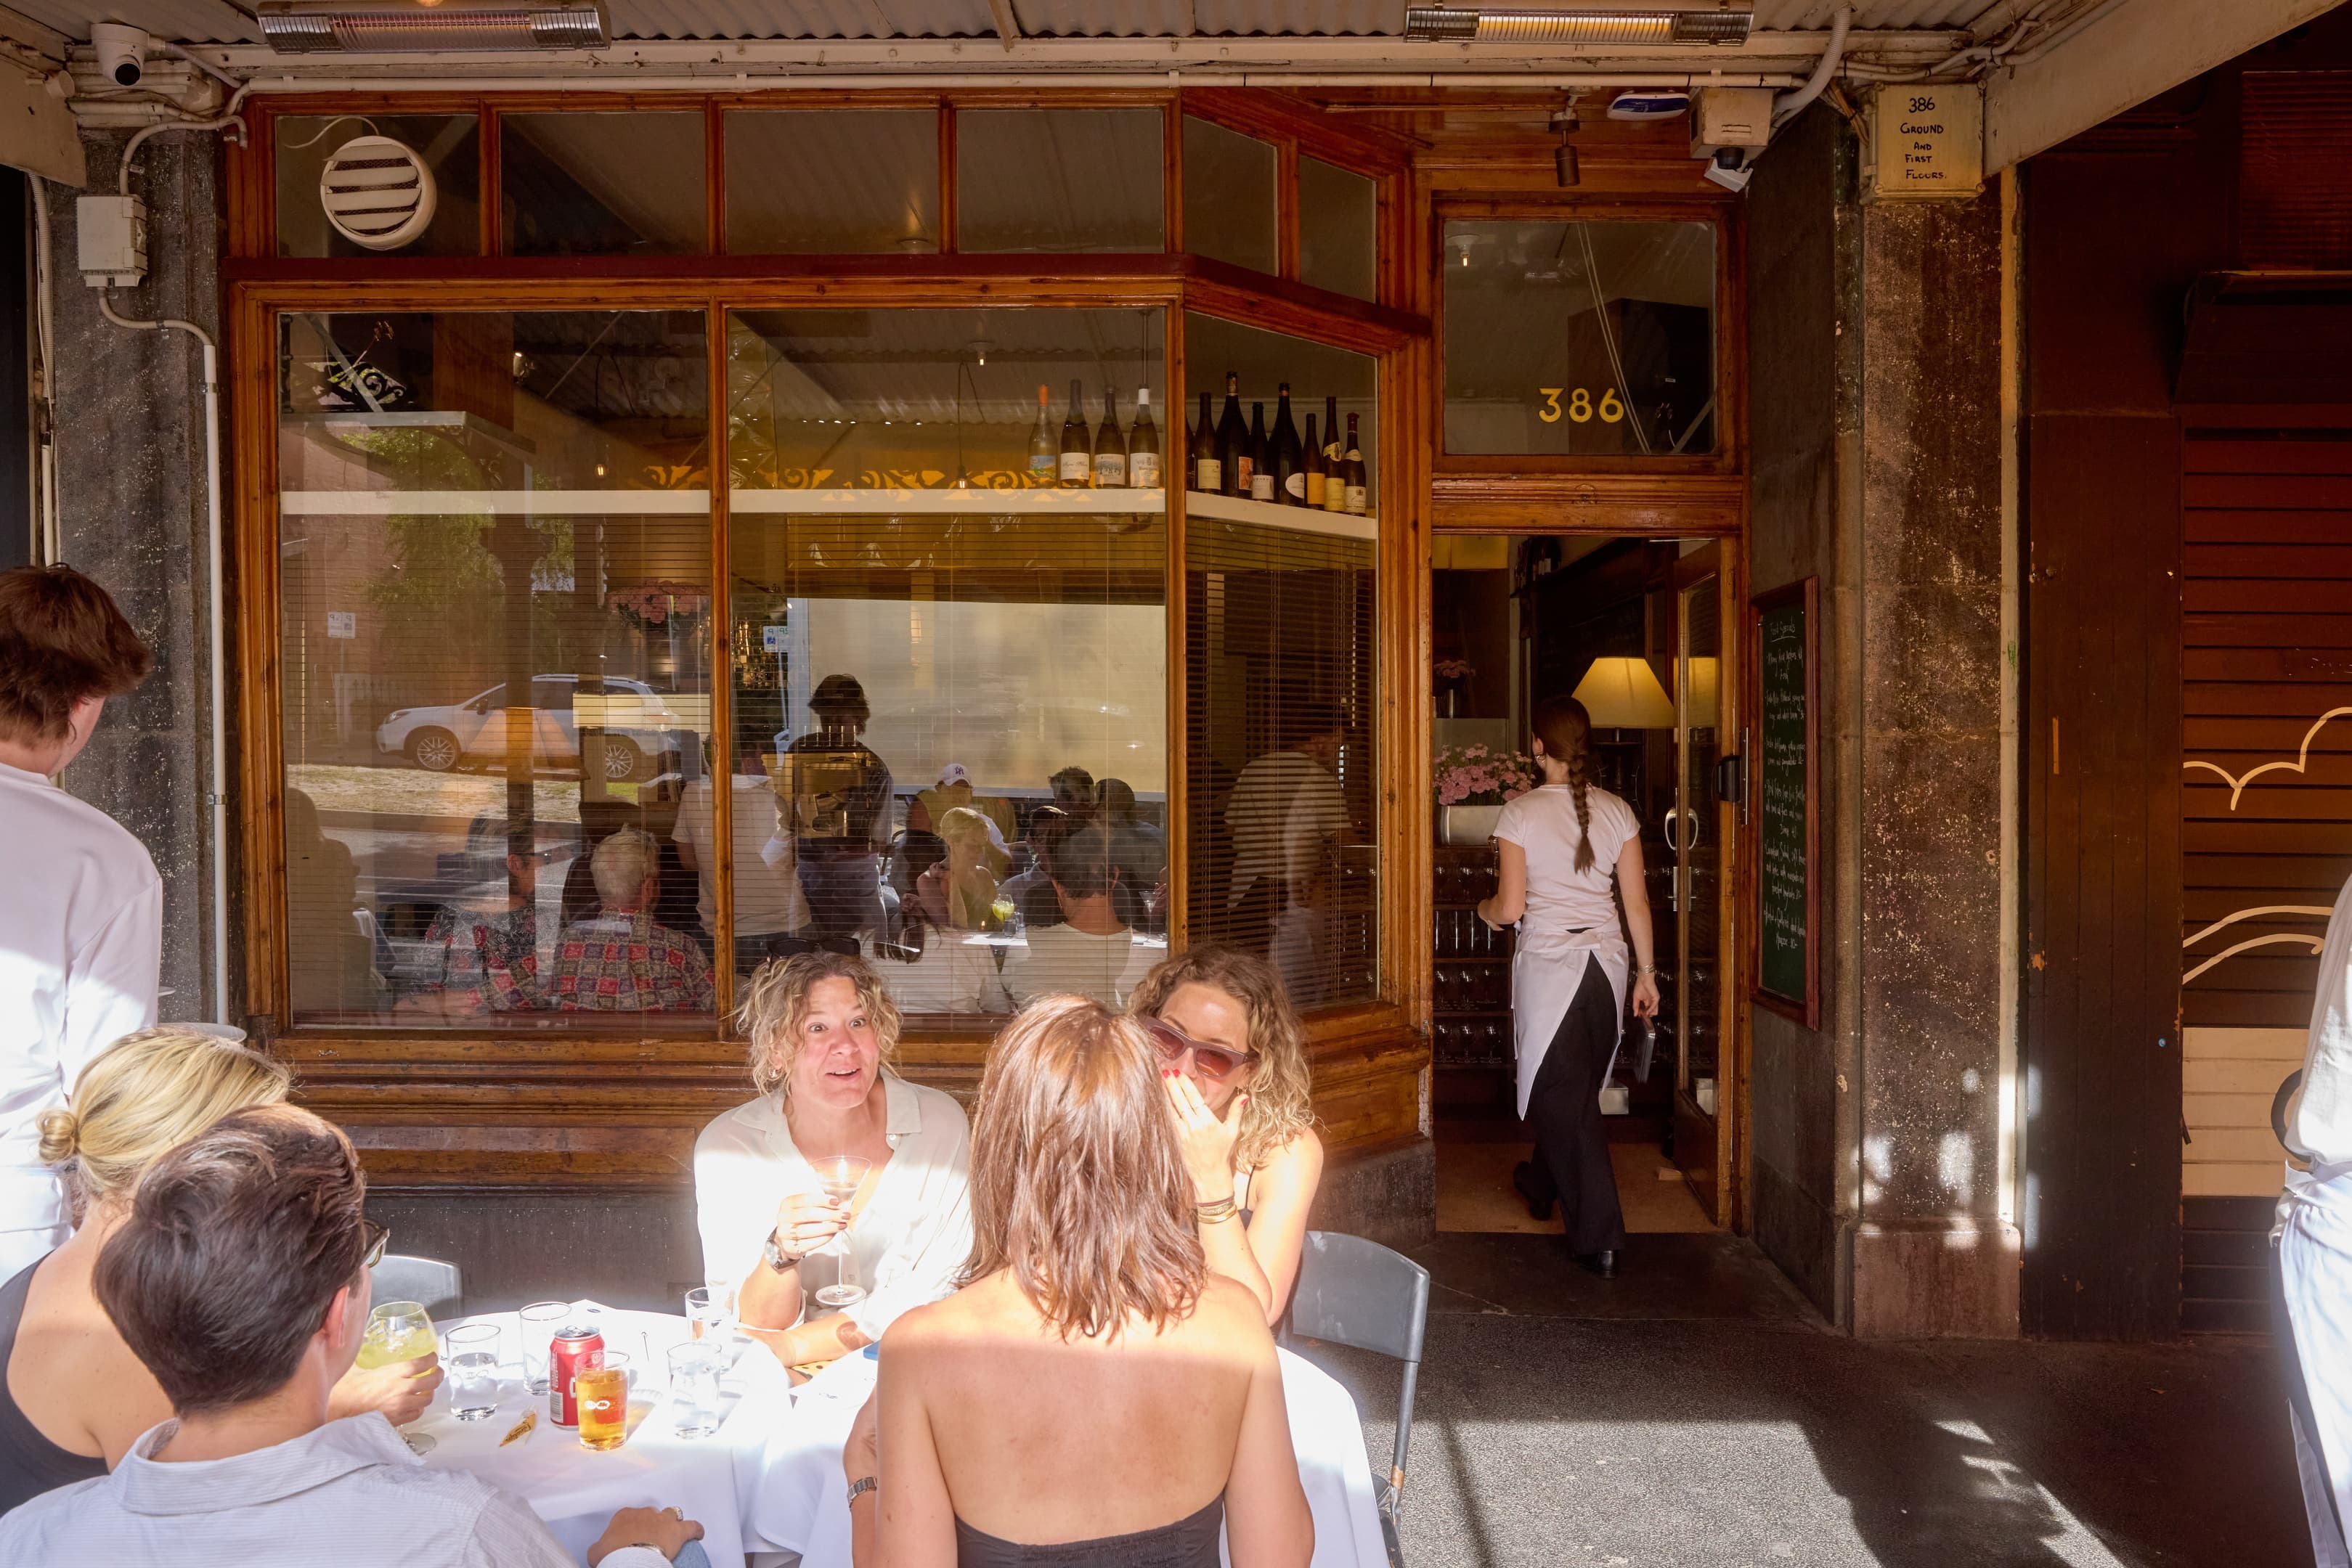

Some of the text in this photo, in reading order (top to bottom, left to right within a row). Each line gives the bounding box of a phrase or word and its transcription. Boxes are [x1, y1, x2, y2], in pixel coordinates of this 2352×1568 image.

[1908, 97, 1935, 113] 386
[1900, 123, 1944, 134] GROUND
[1913, 142, 1932, 151] AND
[1905, 154, 1932, 163] FIRST
[1539, 388, 1624, 423] 386
